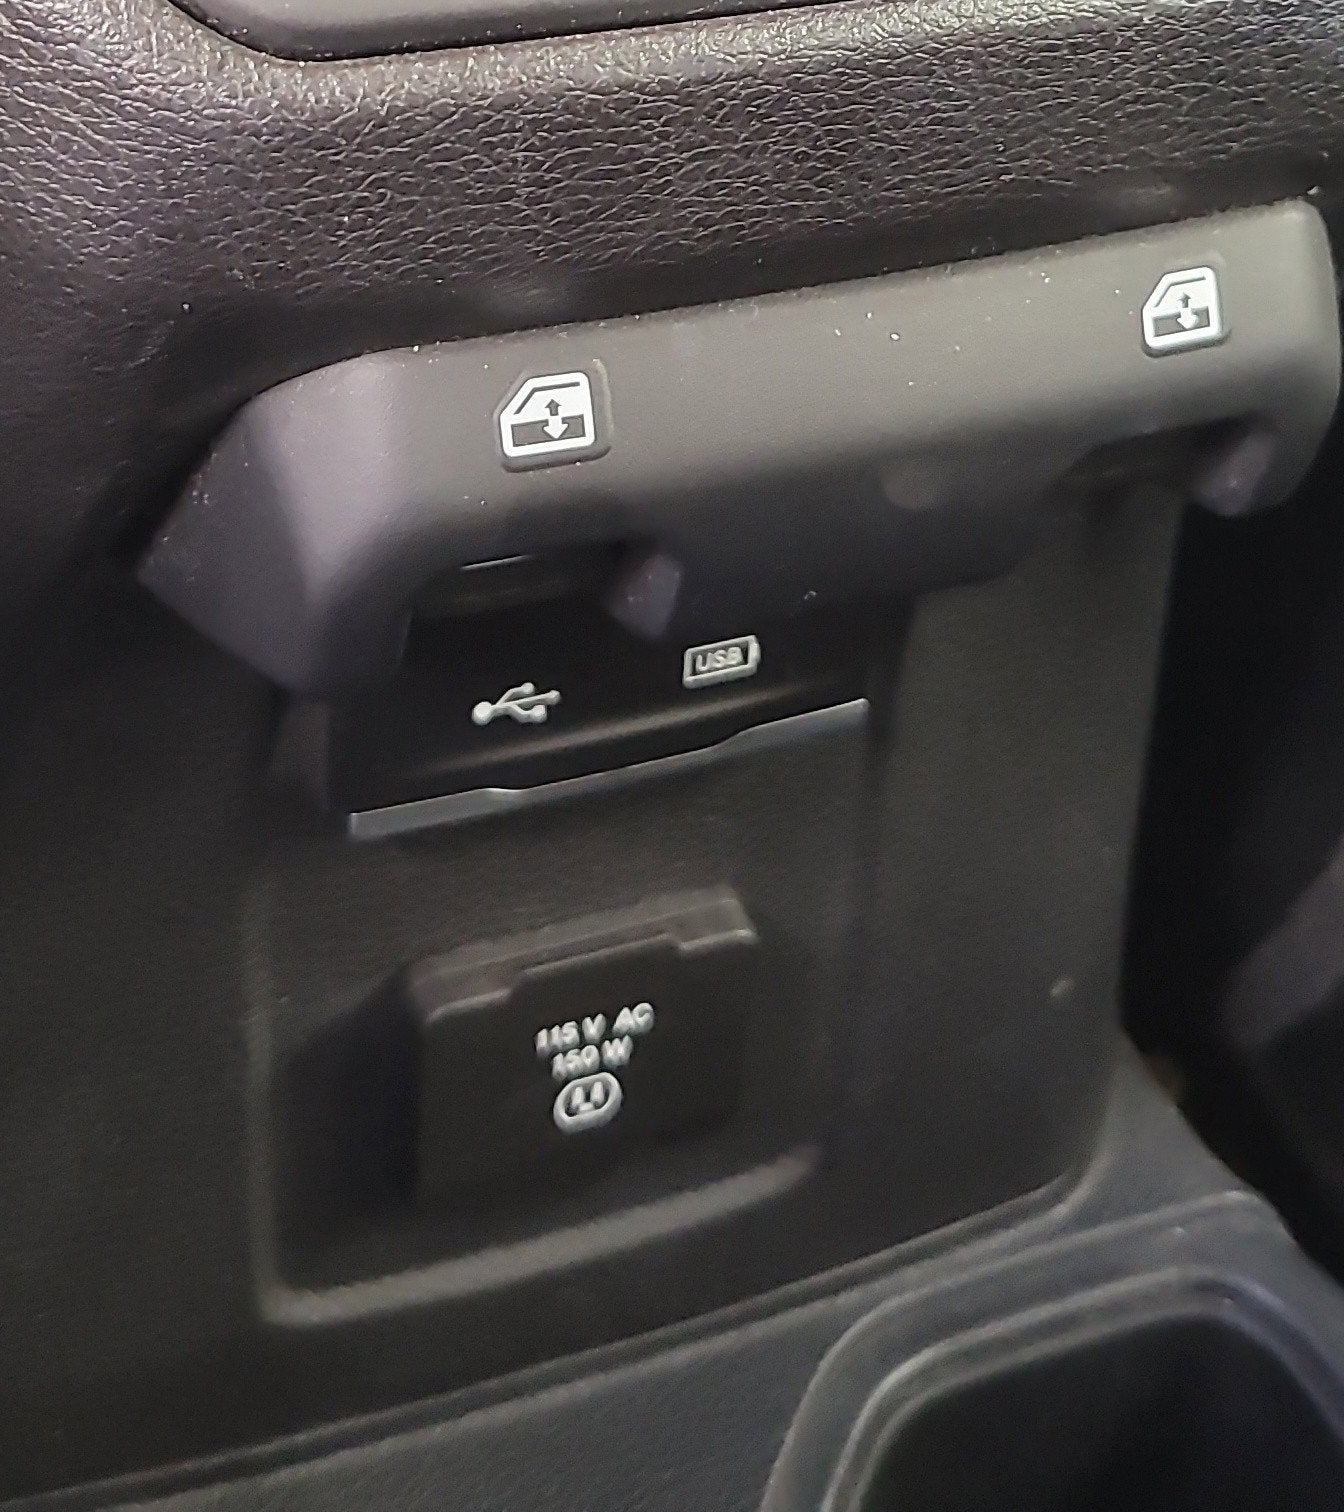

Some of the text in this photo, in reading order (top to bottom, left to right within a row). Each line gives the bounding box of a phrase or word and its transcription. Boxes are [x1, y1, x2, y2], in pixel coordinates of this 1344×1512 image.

[695, 646, 744, 672] USB
[535, 1020, 580, 1057] 115
[612, 1002, 655, 1034] AC
[552, 1044, 600, 1080] 150
